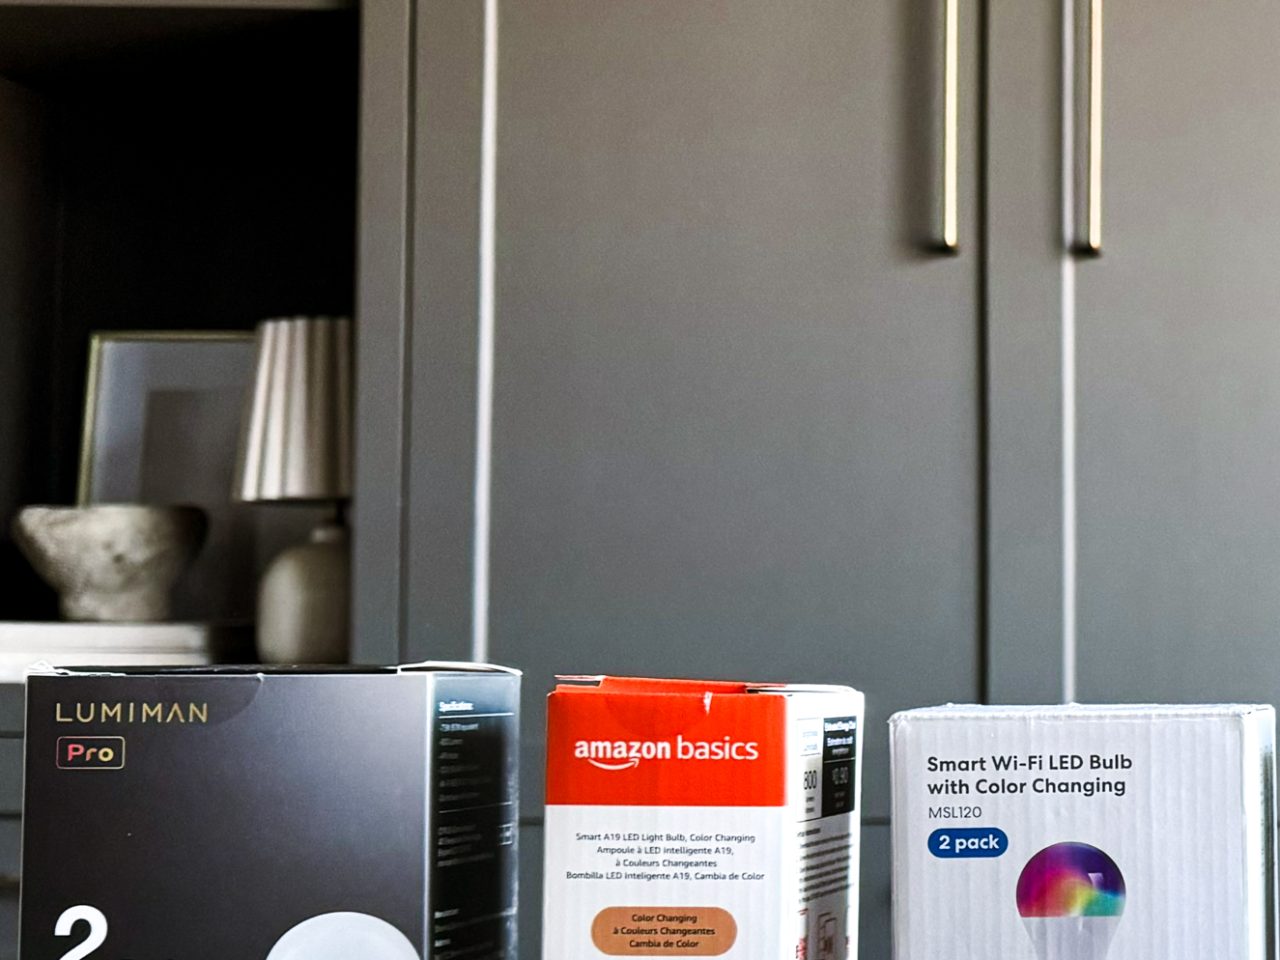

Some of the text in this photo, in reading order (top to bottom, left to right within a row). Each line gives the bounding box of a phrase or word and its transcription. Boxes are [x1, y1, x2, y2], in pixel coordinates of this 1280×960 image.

[56, 702, 208, 723] LUMIMAN
[67, 743, 114, 762] Pro
[574, 735, 759, 760] amazon basics
[927, 754, 1132, 772] Smart Wi-Fi LED Bulb
[927, 777, 1126, 797] with Color Changing
[928, 806, 982, 819] MSL120
[576, 833, 756, 843] Smart A19 LED Light Bulb, Color Changing
[939, 834, 1000, 853] 2 pack
[597, 846, 635, 854] Ampoule
[623, 859, 660, 867] Couleurs
[662, 859, 717, 868] Changeantes
[566, 872, 603, 880] Bombilla
[606, 872, 623, 880] LED
[694, 872, 727, 880] Cambia
[741, 872, 765, 880] Color
[632, 914, 698, 924] Color Changing
[613, 927, 715, 937] à Couleurs Changeantes
[629, 940, 699, 948] Cambia de Color
